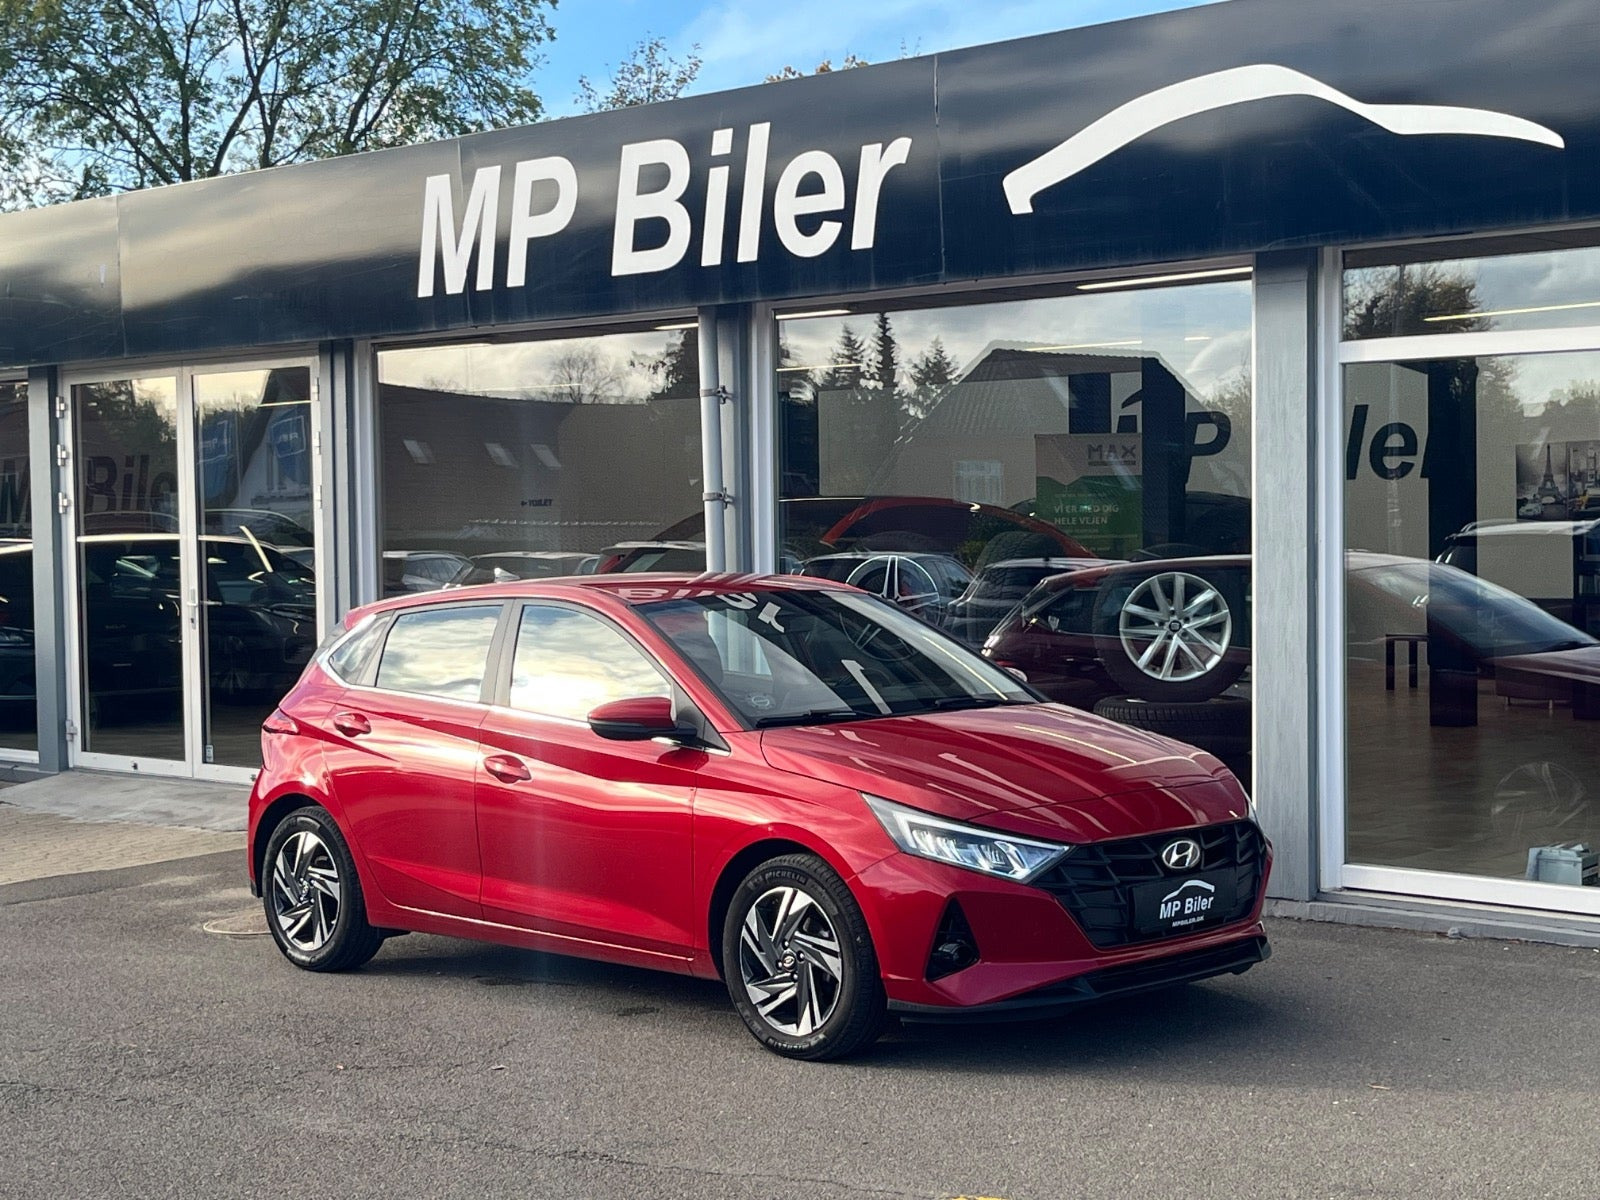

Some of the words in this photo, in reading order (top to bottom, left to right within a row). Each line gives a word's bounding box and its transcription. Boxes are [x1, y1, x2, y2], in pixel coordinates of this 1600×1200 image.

[417, 155, 578, 298] MP
[611, 121, 913, 277] Biler
[1087, 444, 1137, 460] MAX
[1102, 504, 1120, 513] DIG
[1160, 901, 1181, 919] MP
[1184, 896, 1214, 914] Biler
